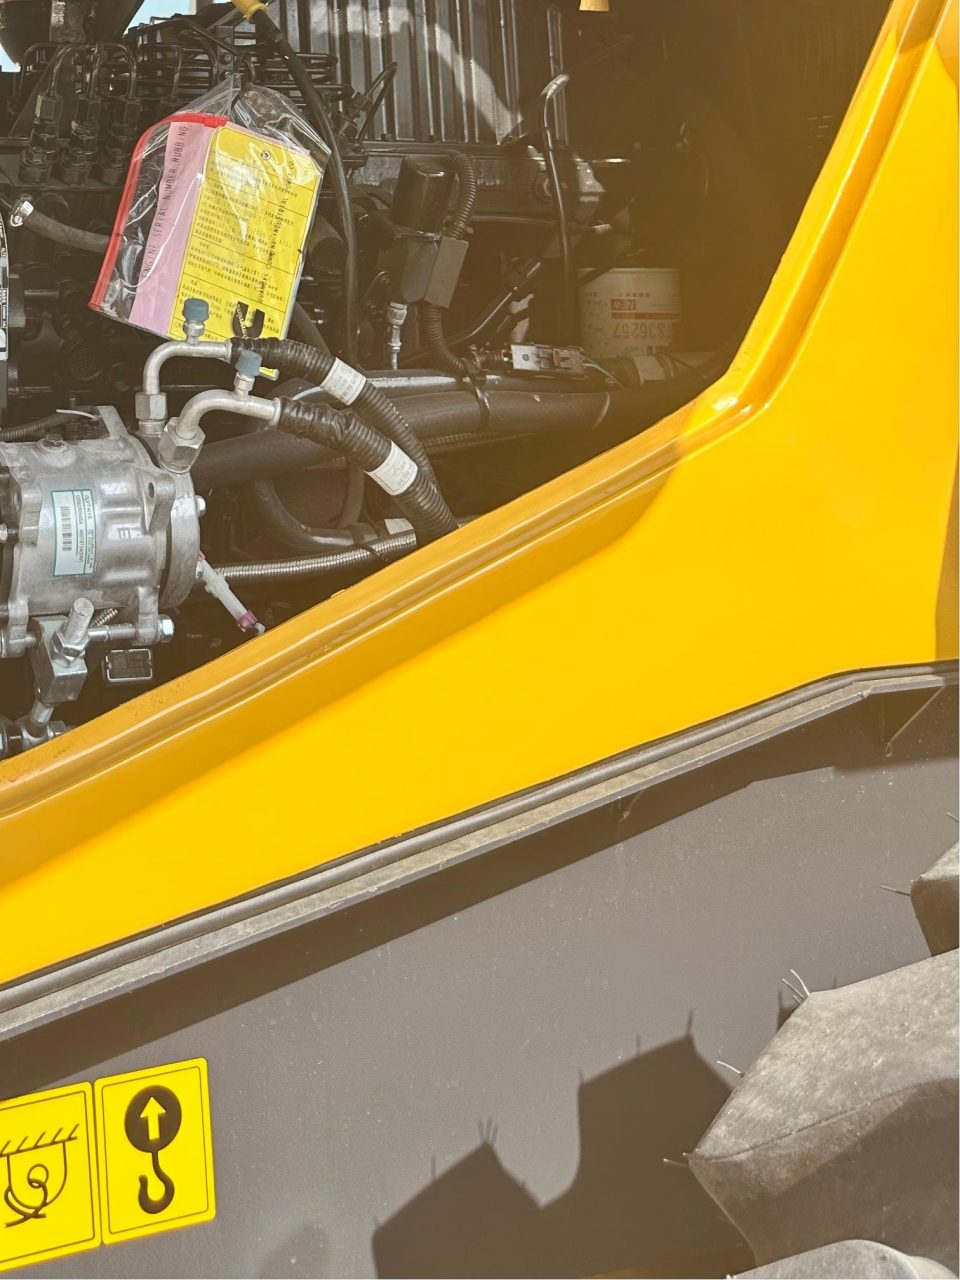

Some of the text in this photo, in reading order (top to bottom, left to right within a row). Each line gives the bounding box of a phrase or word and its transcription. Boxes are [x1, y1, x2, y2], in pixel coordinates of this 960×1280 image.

[142, 125, 189, 279] ENGINE SERIAL NUMBER RUBBING
